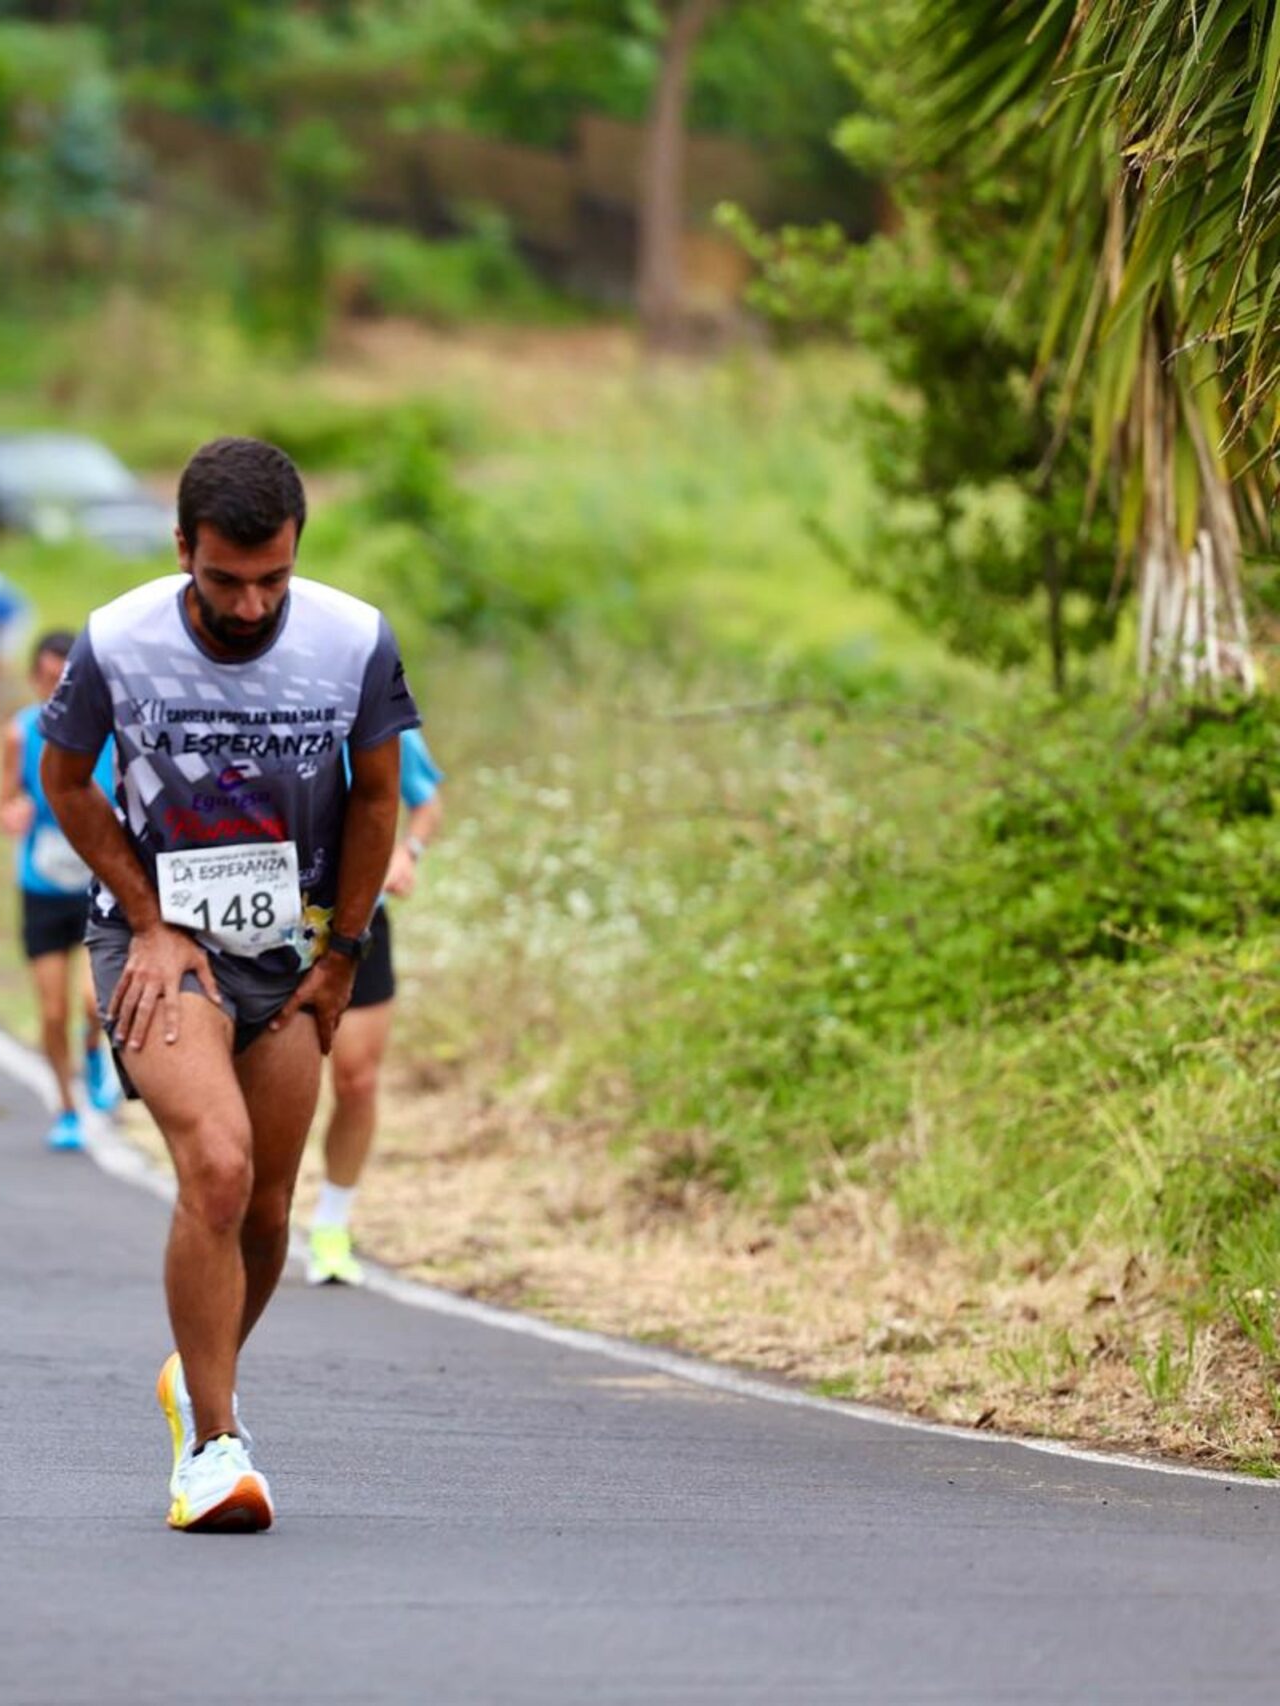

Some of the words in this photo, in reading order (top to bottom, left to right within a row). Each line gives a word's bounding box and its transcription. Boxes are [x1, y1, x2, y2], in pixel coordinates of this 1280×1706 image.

[141, 731, 172, 757] LA
[182, 730, 334, 758] ESPERANZA
[173, 867, 194, 883] LA
[199, 857, 289, 881] ESPERANZA
[193, 891, 275, 932] 148
